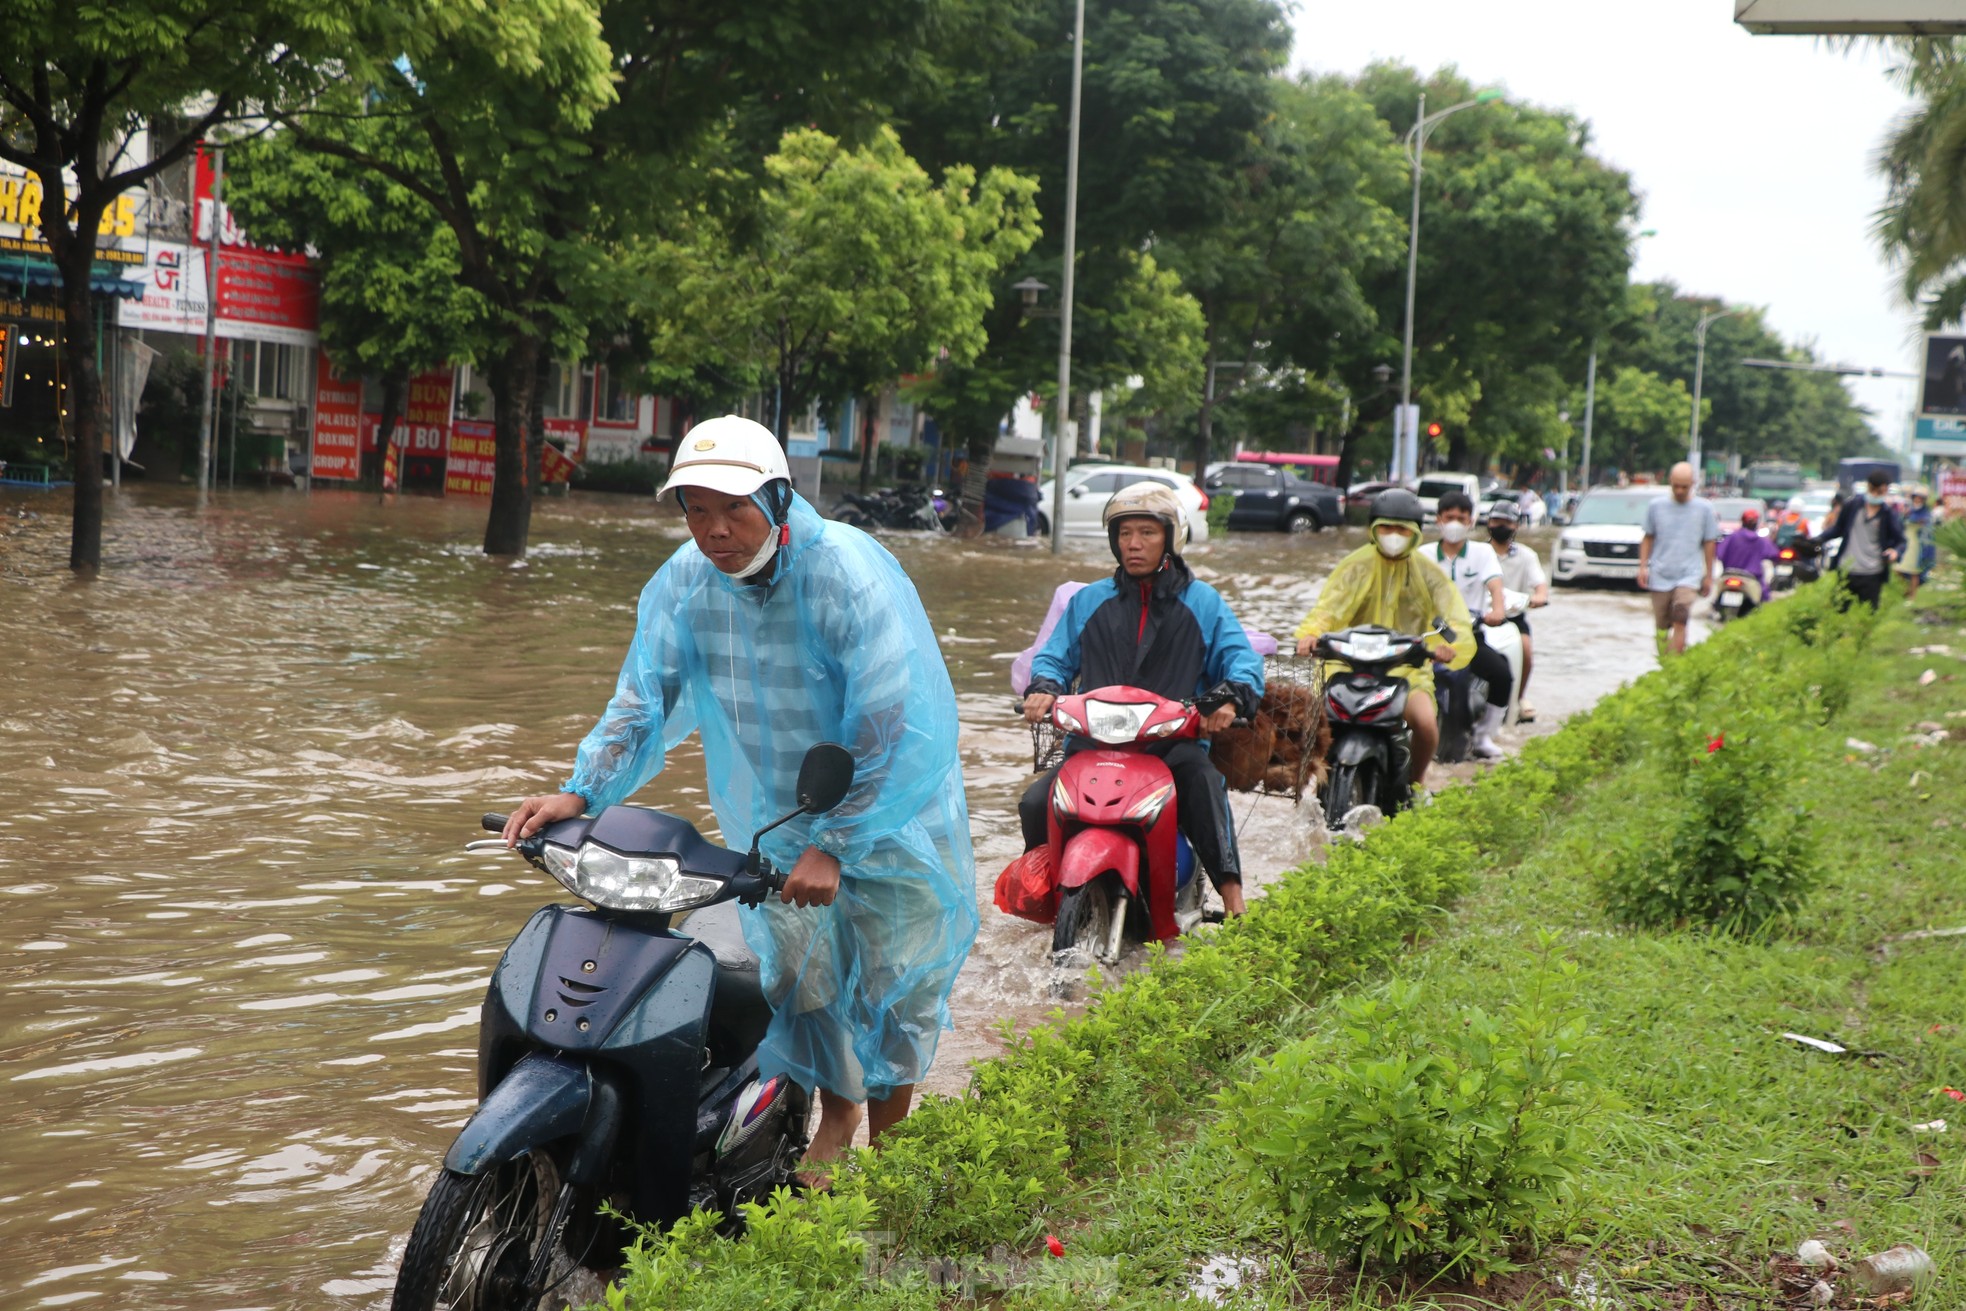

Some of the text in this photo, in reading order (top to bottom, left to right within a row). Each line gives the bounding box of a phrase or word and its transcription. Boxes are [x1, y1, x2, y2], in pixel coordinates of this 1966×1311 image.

[176, 299, 206, 313] FITNESS
[411, 380, 449, 404] BÚN
[317, 412, 357, 427] PILATES
[318, 431, 355, 447] BOXING
[314, 454, 356, 470] GROUP X
[448, 476, 471, 491] NEM
[1096, 761, 1126, 769] HONDA
